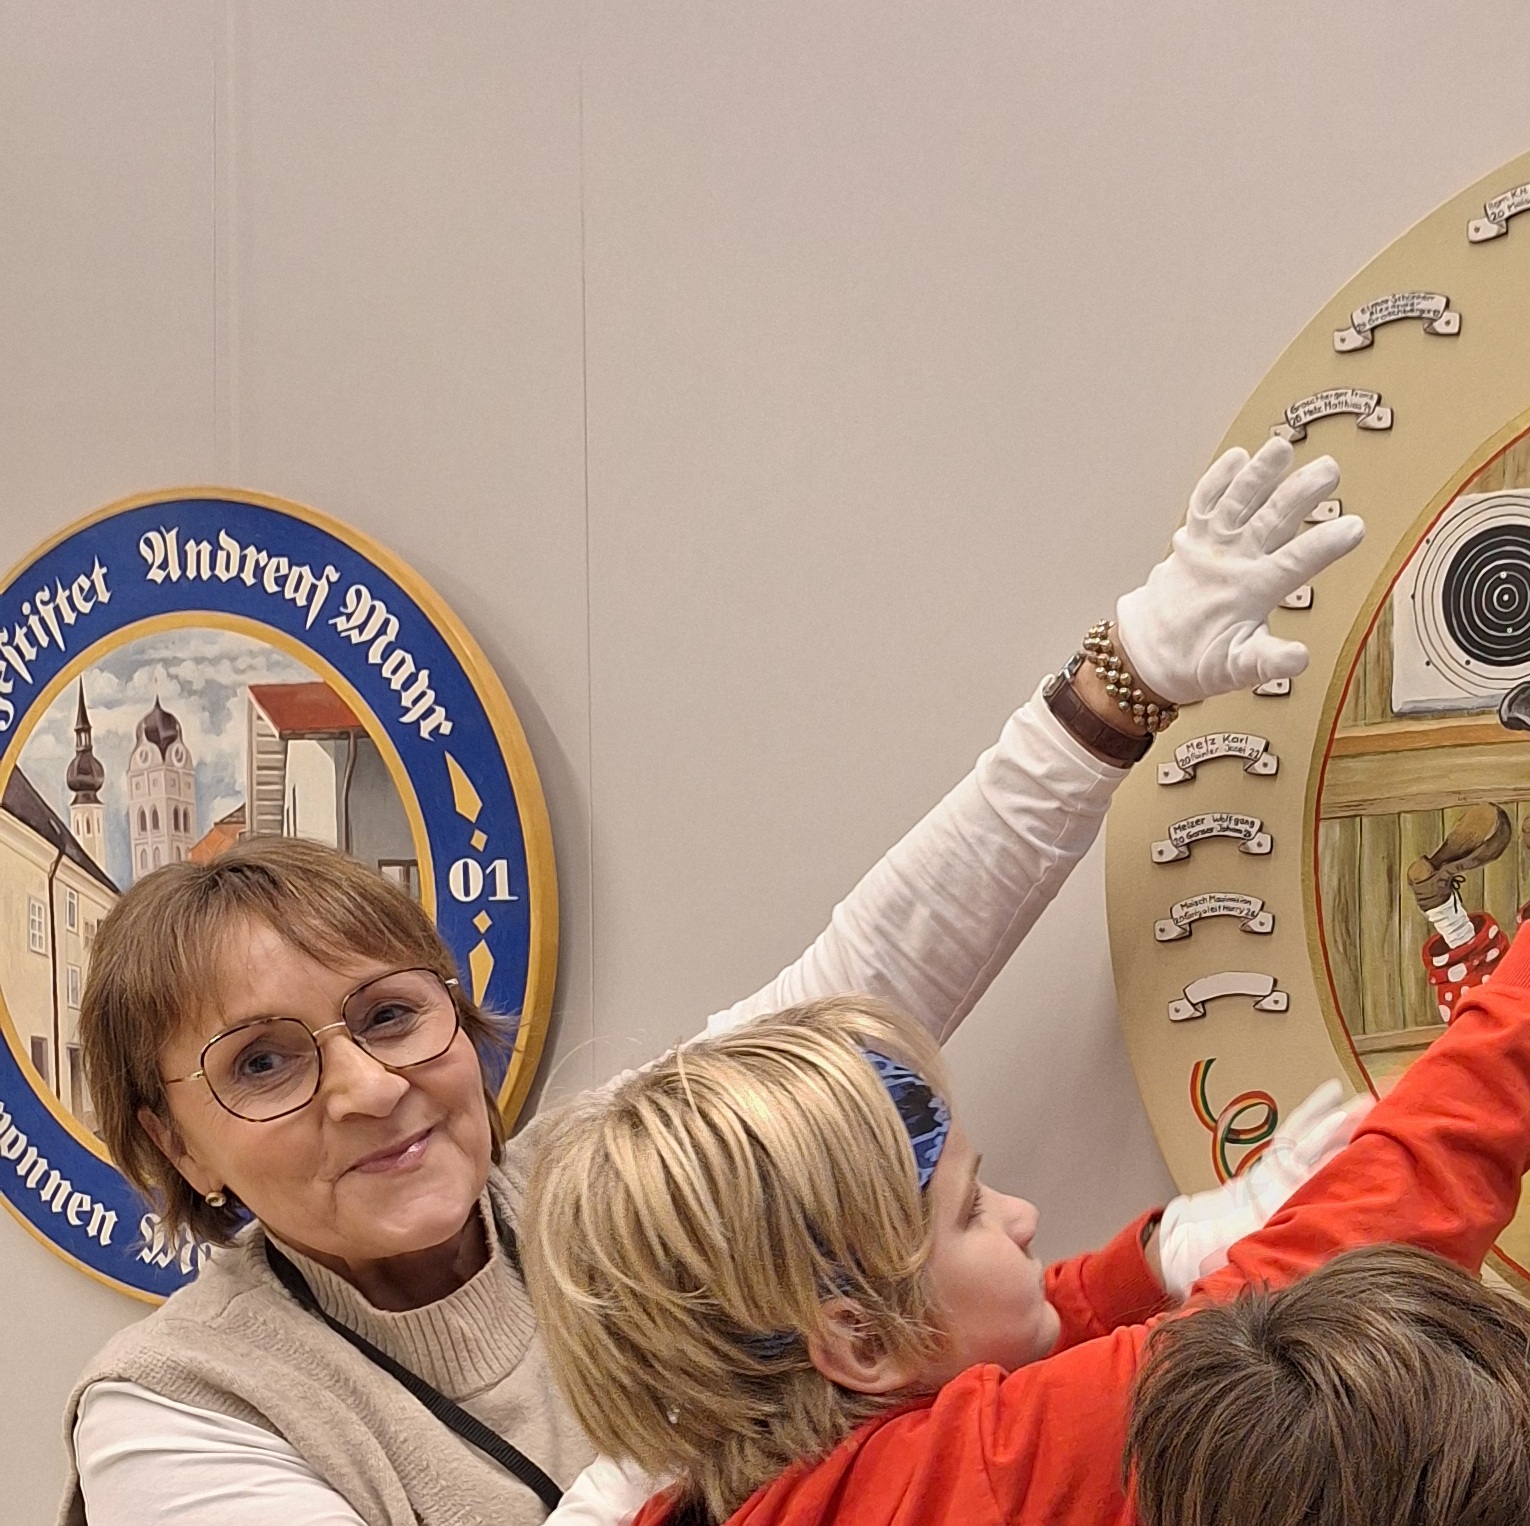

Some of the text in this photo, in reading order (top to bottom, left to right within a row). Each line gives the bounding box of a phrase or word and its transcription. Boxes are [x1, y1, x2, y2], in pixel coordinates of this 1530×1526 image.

[1490, 210, 1505, 222] 20
[1186, 734, 1249, 753] Metz Karl
[1180, 756, 1191, 767] 20
